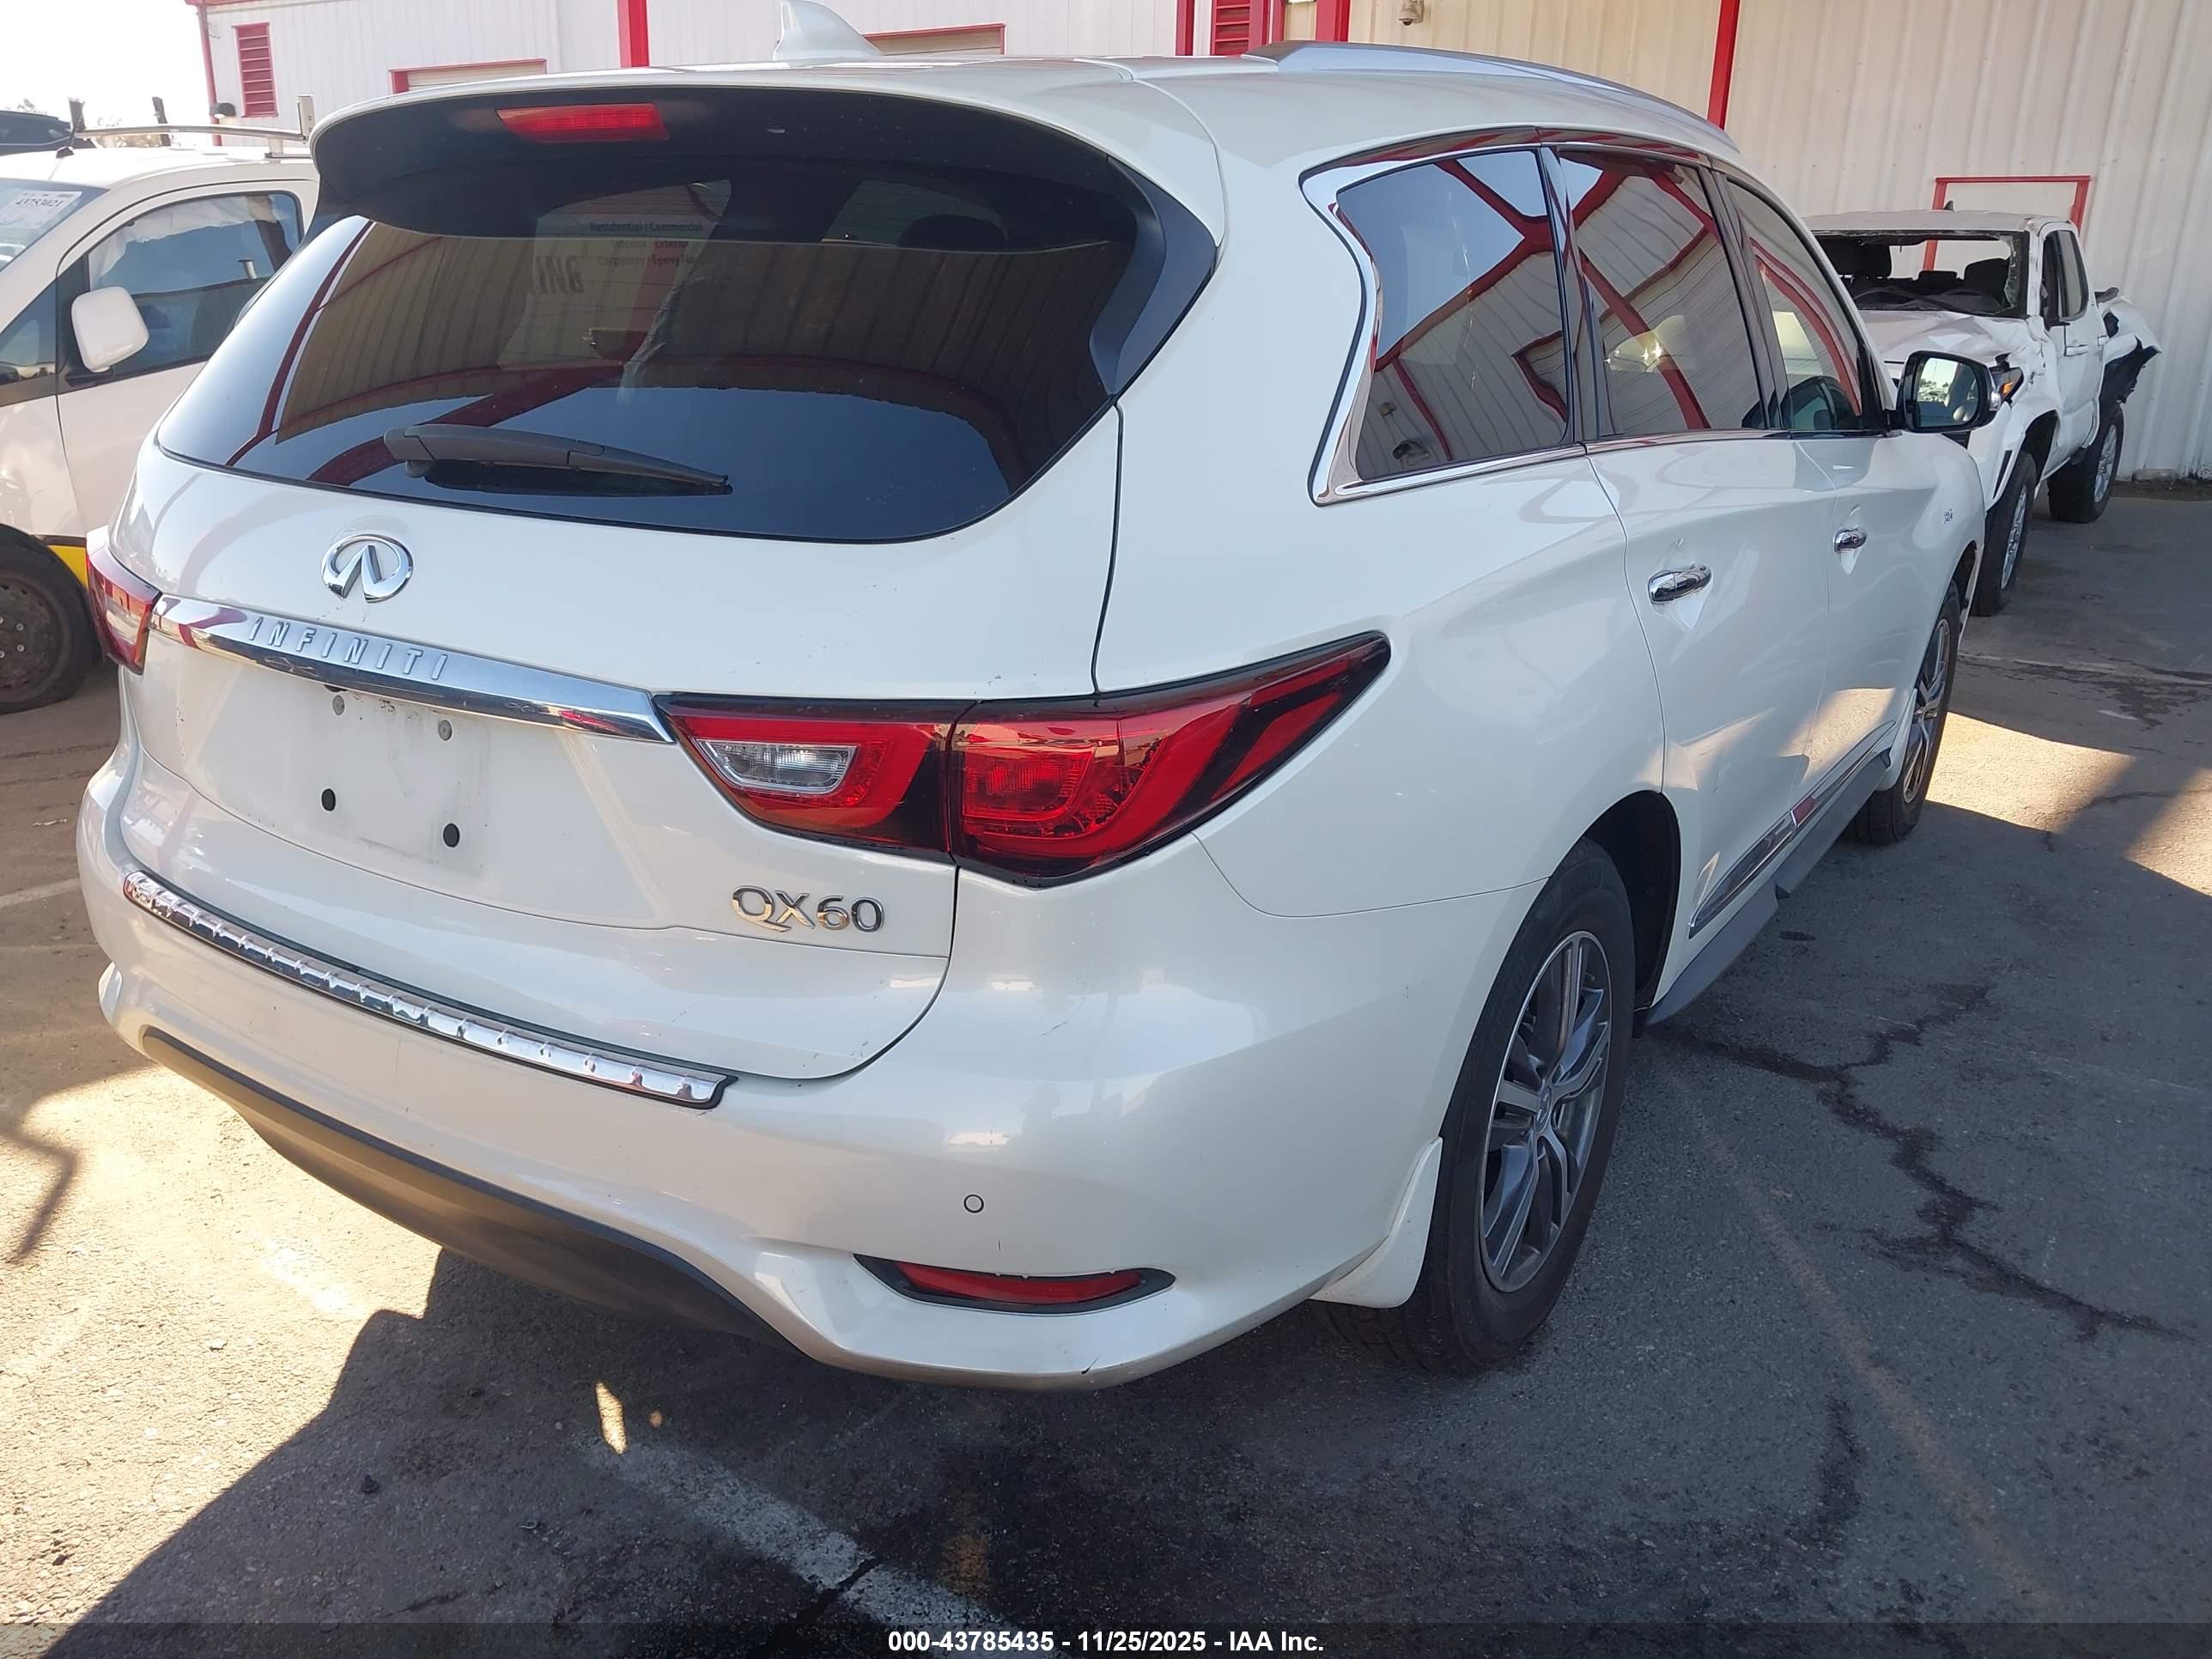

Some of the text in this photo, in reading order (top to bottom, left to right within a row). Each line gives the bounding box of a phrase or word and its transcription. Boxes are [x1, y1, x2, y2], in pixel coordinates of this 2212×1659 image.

[654, 240, 689, 248] Exterior
[248, 616, 447, 681] INFINITI
[732, 885, 885, 933] QX60
